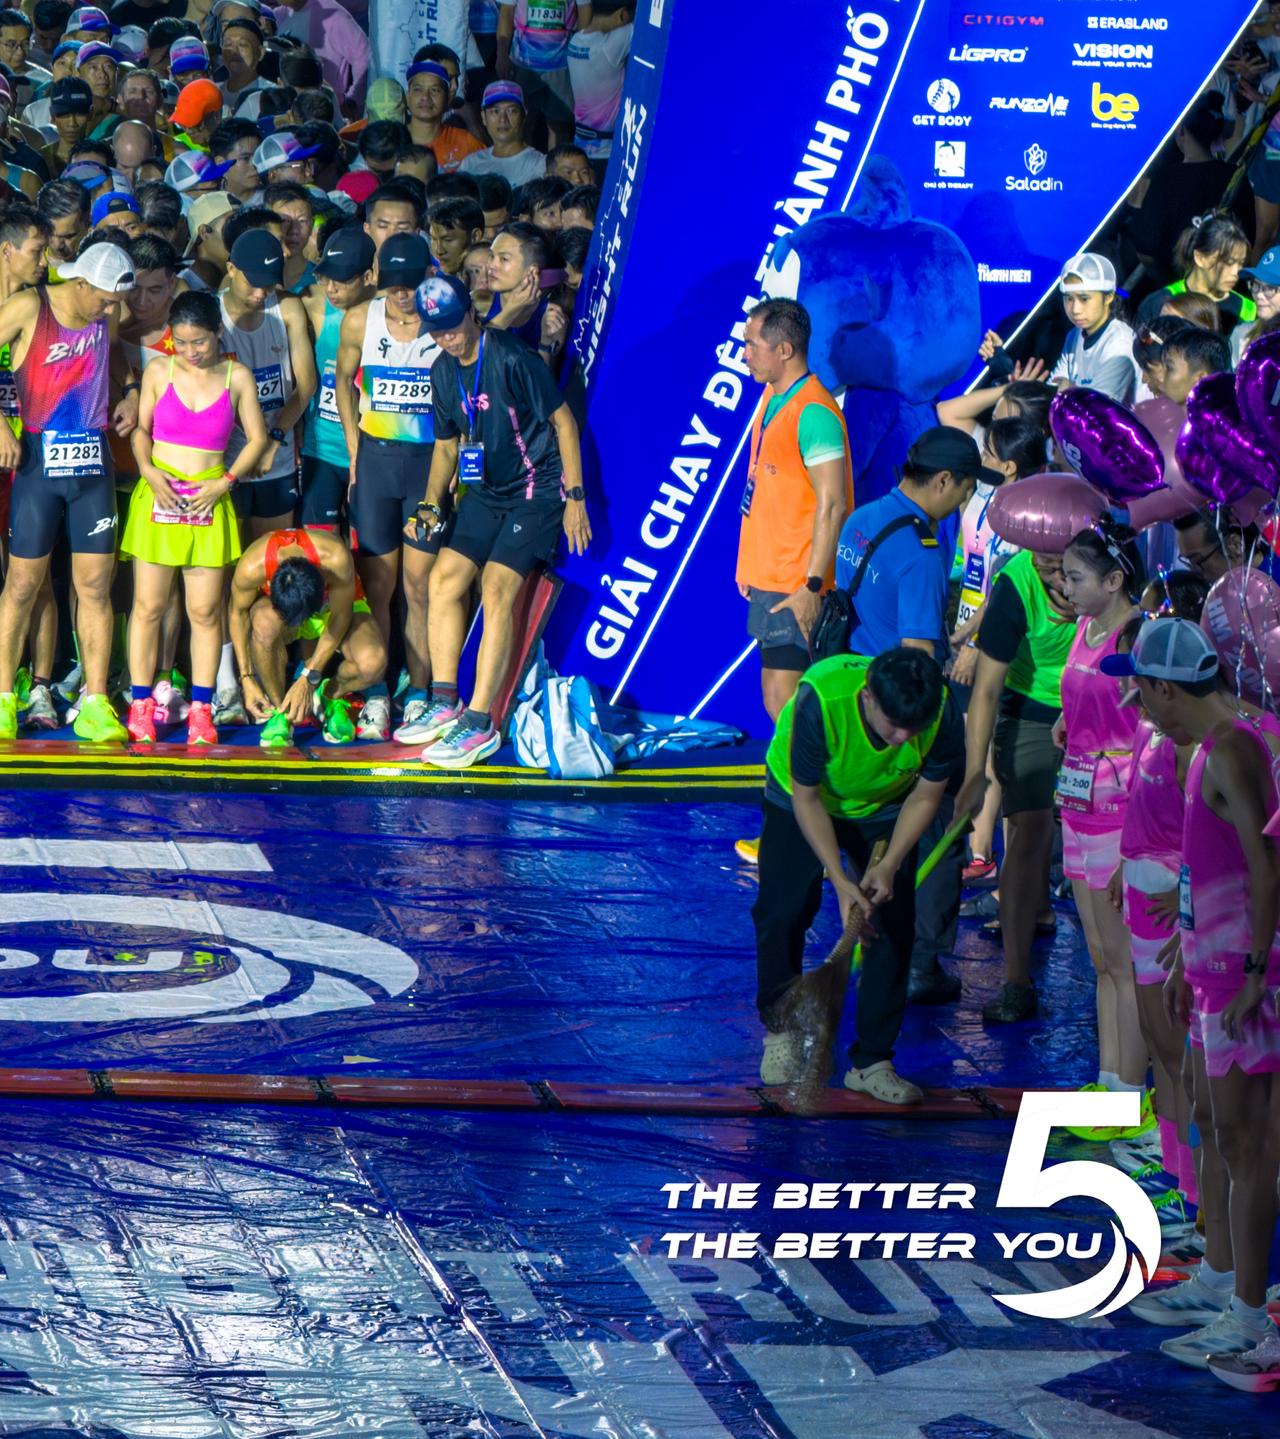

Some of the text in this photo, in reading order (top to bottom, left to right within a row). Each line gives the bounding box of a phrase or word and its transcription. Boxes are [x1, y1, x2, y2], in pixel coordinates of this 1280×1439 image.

[963, 14, 1045, 26] CITIGYM
[1100, 17, 1168, 30] ERASLAND
[1073, 43, 1153, 59] VISION
[1092, 82, 1140, 121] be
[912, 115, 972, 127] GET BODY
[1005, 175, 1063, 191] Saladin
[585, 556, 658, 660] GIẢI
[641, 414, 722, 550] CHẠY
[826, 6, 890, 115] PHỐ
[377, 381, 431, 398] 21289
[49, 444, 101, 461] 21282
